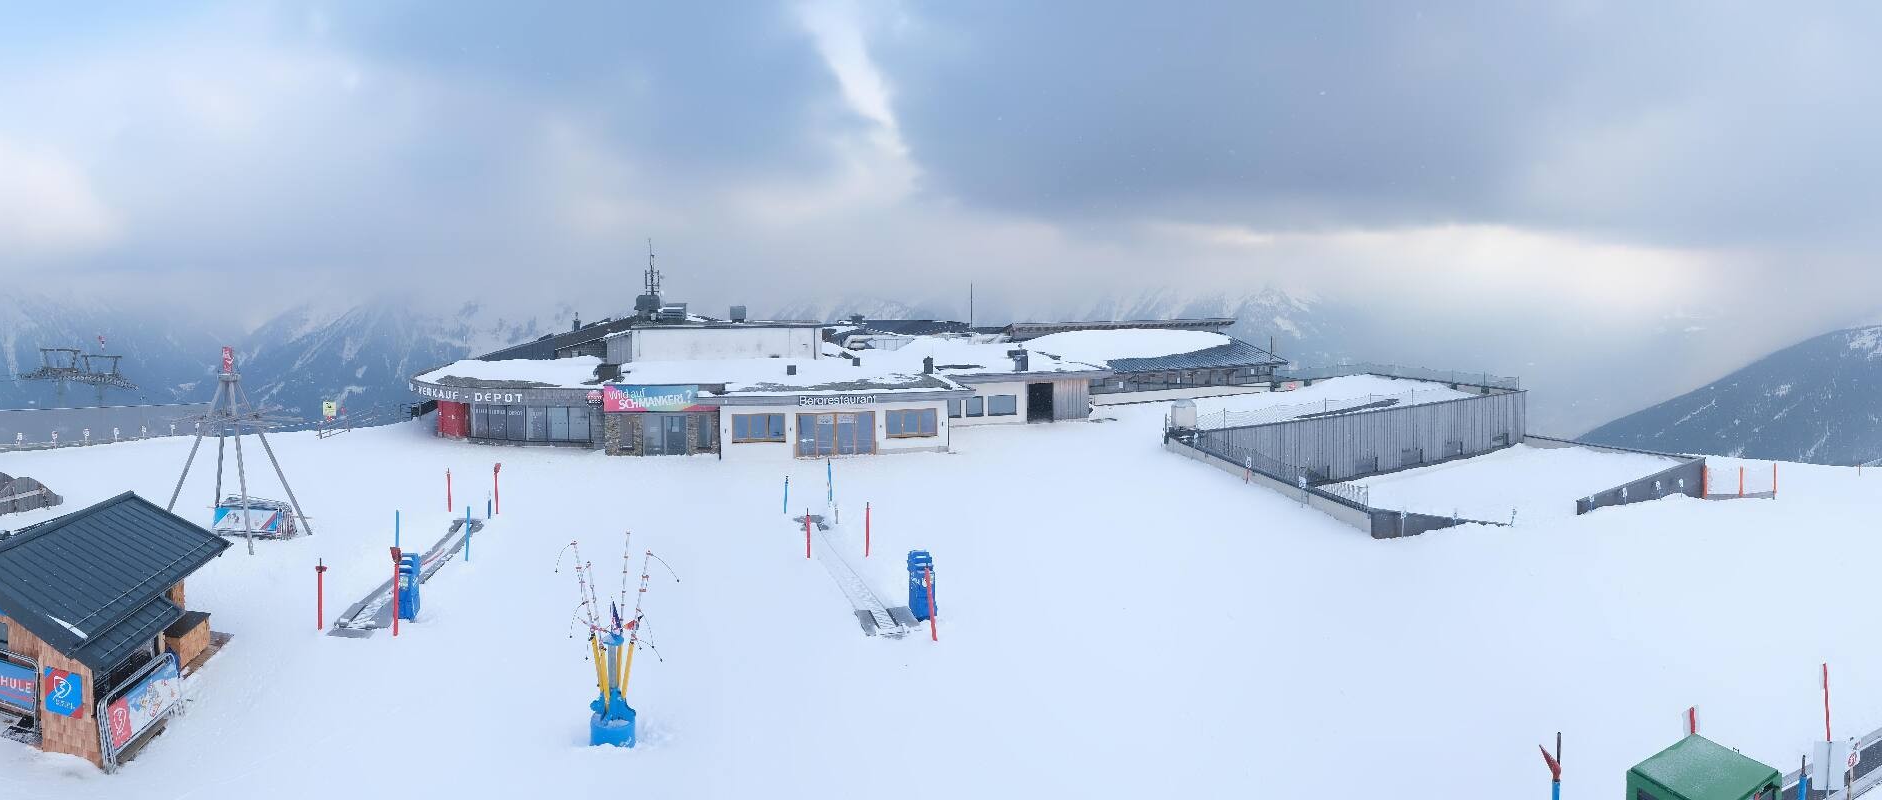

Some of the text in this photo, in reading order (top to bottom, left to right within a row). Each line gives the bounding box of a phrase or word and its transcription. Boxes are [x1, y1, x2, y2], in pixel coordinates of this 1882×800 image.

[418, 385, 459, 400] VERKAUF
[474, 392, 523, 403] DEPOT
[609, 387, 646, 400] Wild auf
[799, 394, 877, 406] Bergrestaurant
